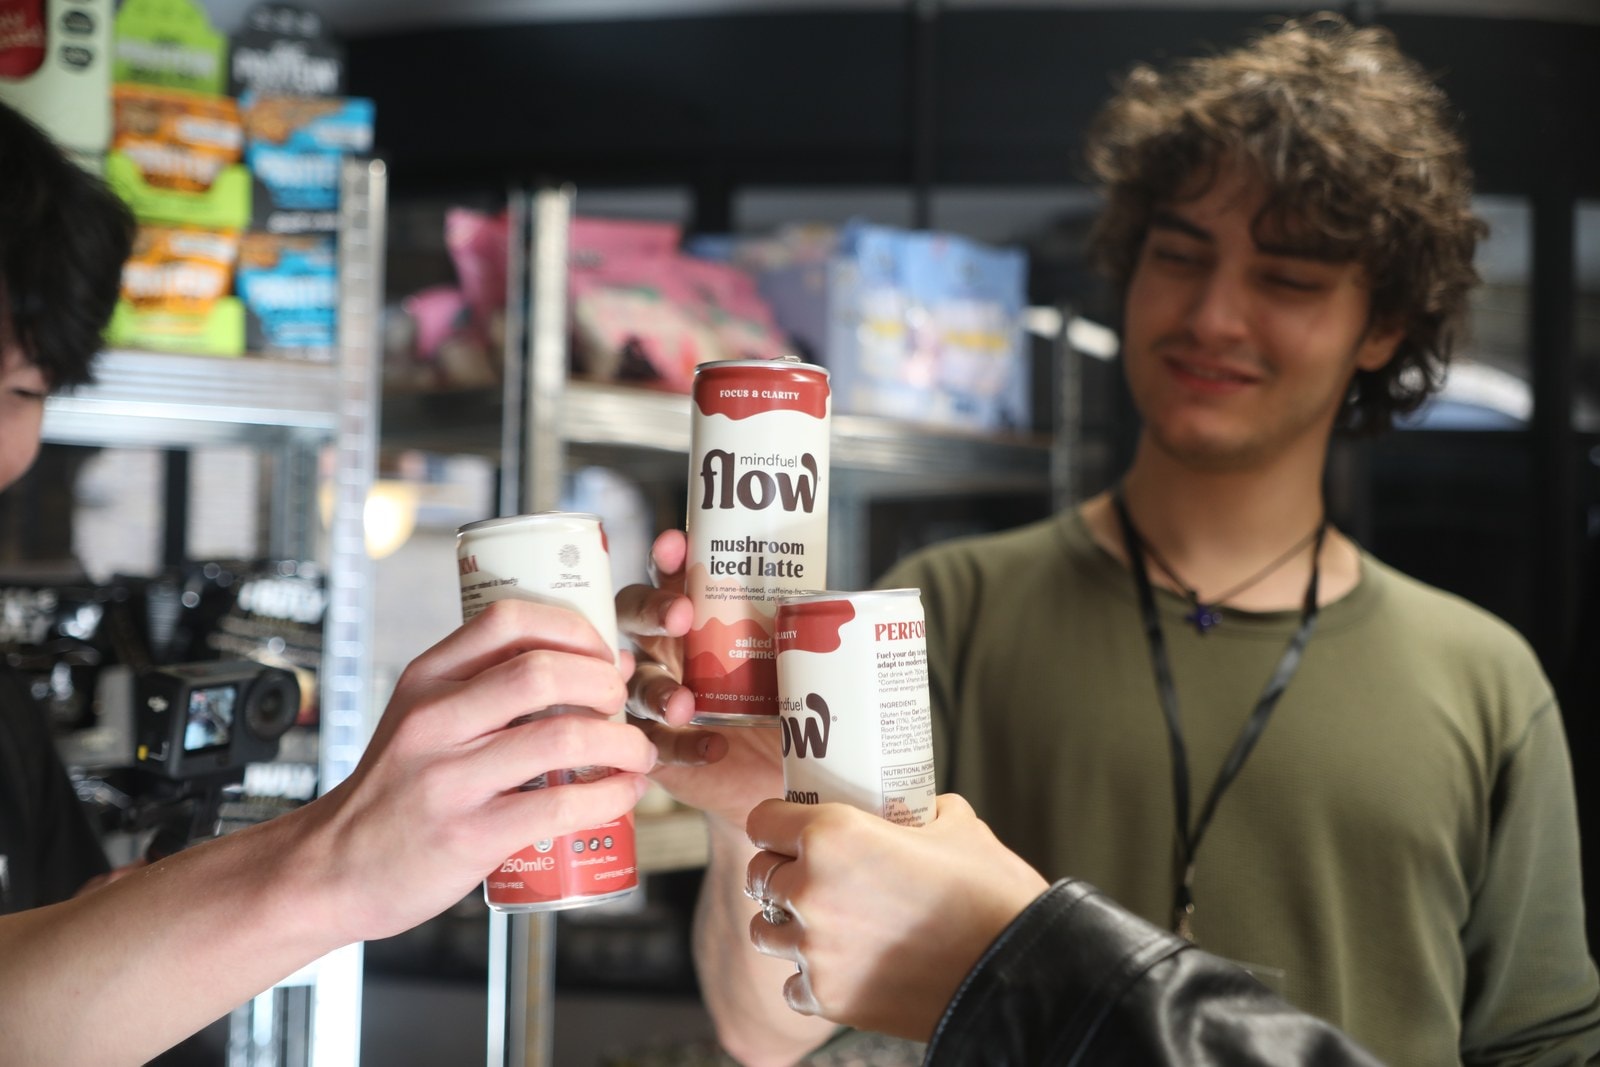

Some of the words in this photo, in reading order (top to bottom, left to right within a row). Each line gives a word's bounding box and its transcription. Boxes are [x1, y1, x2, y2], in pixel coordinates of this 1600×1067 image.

[720, 390, 749, 398] FOCUS
[752, 390, 759, 398] &
[761, 390, 800, 400] CLARITY
[740, 453, 798, 468] mindfuel
[700, 449, 818, 514] flow
[710, 536, 805, 555] mushroom
[710, 556, 752, 576] iced
[758, 556, 804, 578] latte
[705, 593, 728, 601] naturally
[735, 636, 772, 648] salted
[892, 651, 906, 660] your
[908, 650, 916, 659] day
[877, 661, 897, 669] adapt
[880, 700, 916, 709] INGREDIENTS
[881, 732, 913, 741] Flavourings,
[882, 747, 912, 755] Carbonate,
[884, 766, 920, 776] NUTRITIONAL
